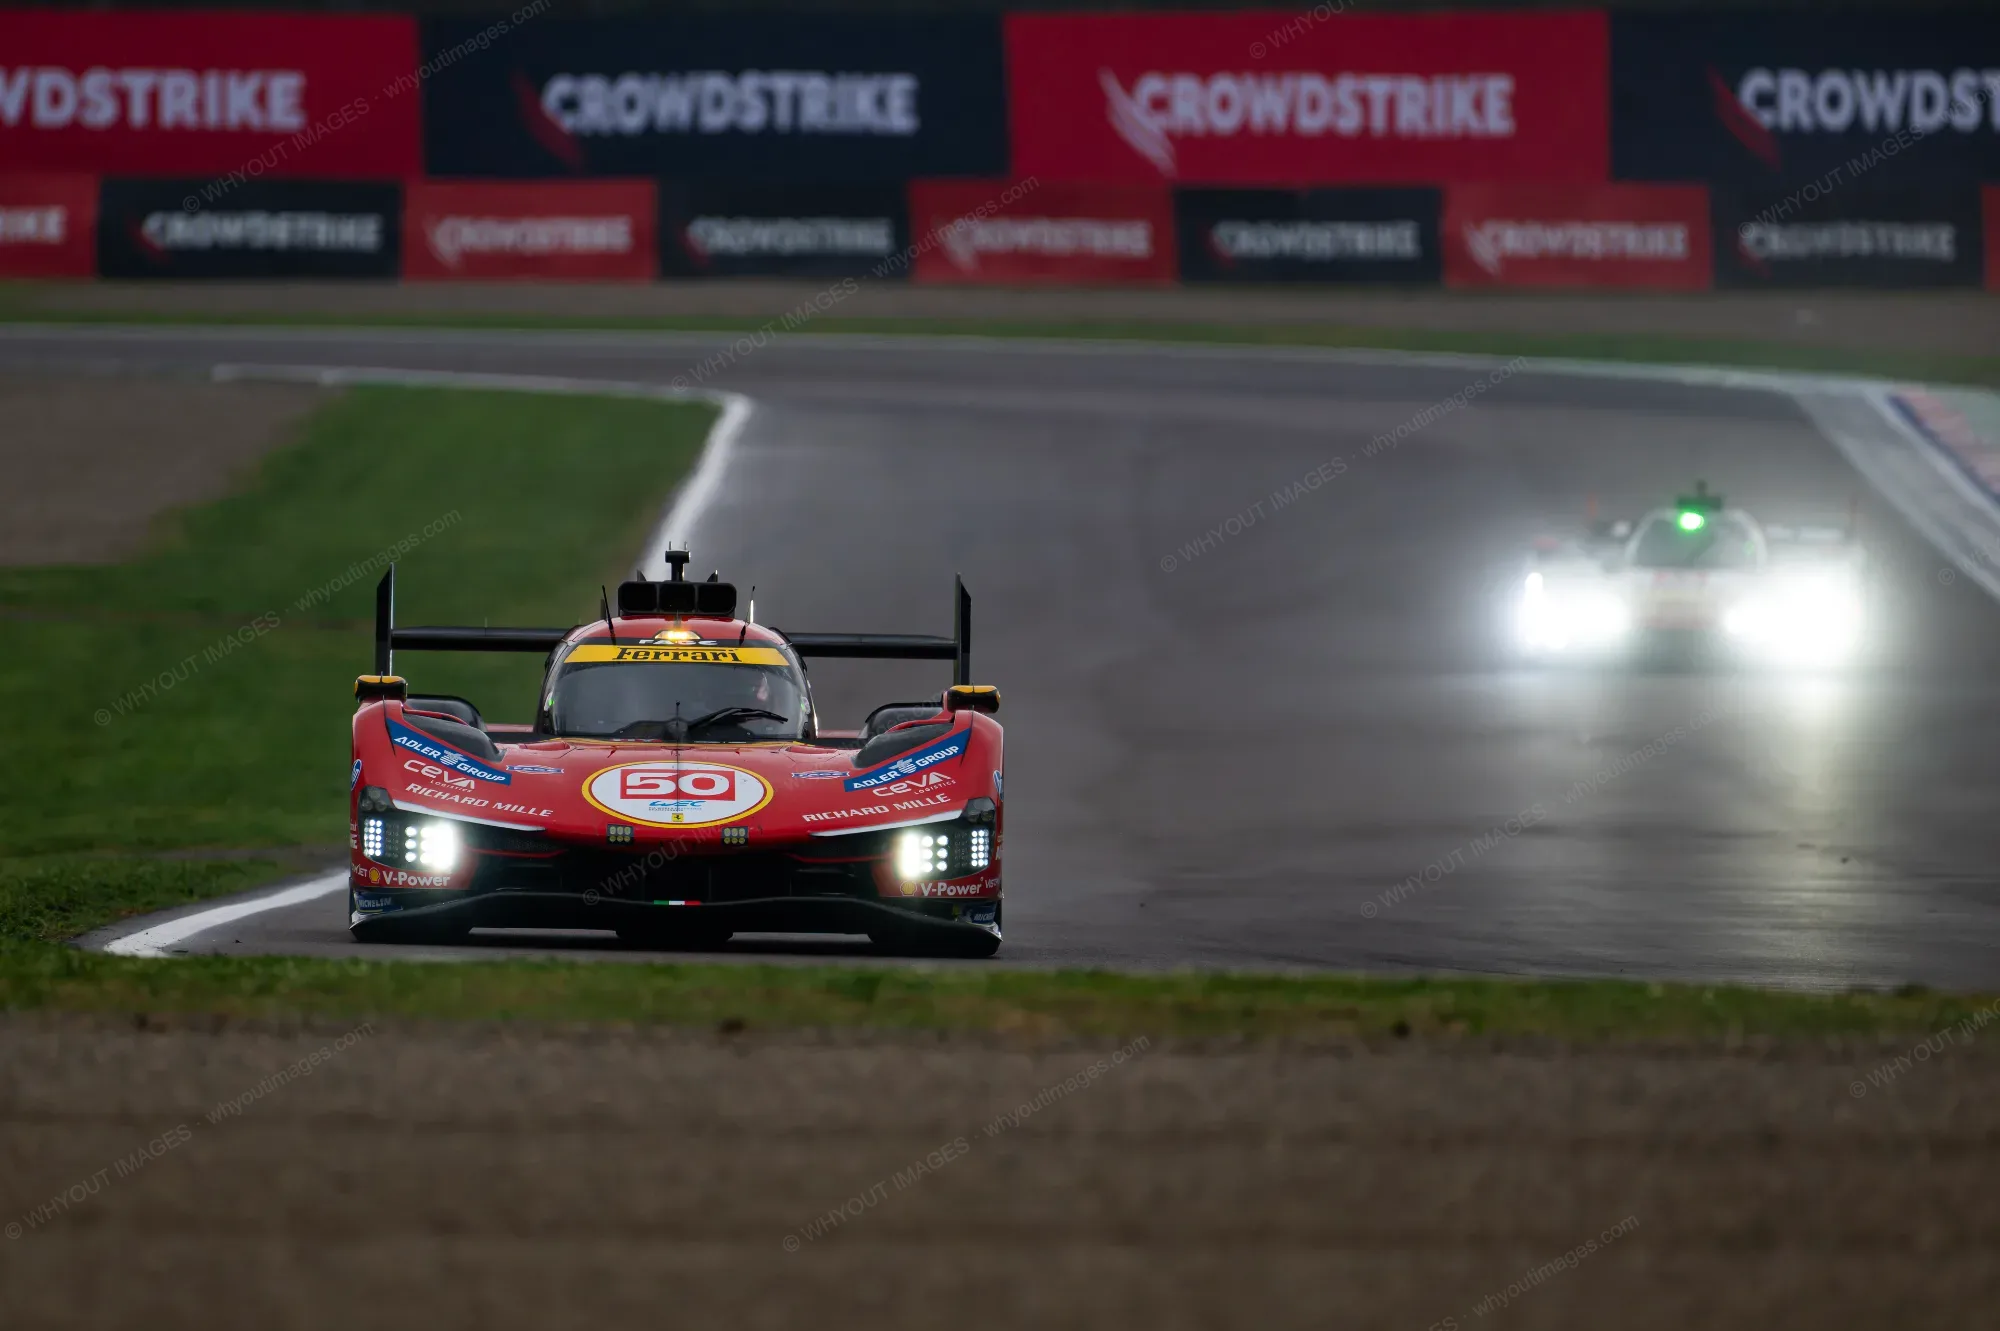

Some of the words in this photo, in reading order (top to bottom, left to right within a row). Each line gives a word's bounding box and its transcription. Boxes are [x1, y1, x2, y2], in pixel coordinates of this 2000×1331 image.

[542, 71, 918, 134] CROWDSTRIKE
[1134, 72, 1514, 136] CROWDSTRIKE
[612, 647, 743, 662] Ferrari
[394, 736, 442, 759] ADLER
[457, 762, 506, 782] GROUP
[853, 770, 901, 789] ADLER
[915, 745, 960, 767] GROUP
[625, 772, 730, 796] 50
[914, 779, 957, 795] LOGISTICS
[405, 783, 489, 807] RICHARD
[492, 802, 554, 817] MILLE
[802, 804, 890, 822] RICHARD
[893, 793, 951, 811] MILLE
[383, 870, 451, 886] V-Power
[920, 882, 982, 897] V-Power
